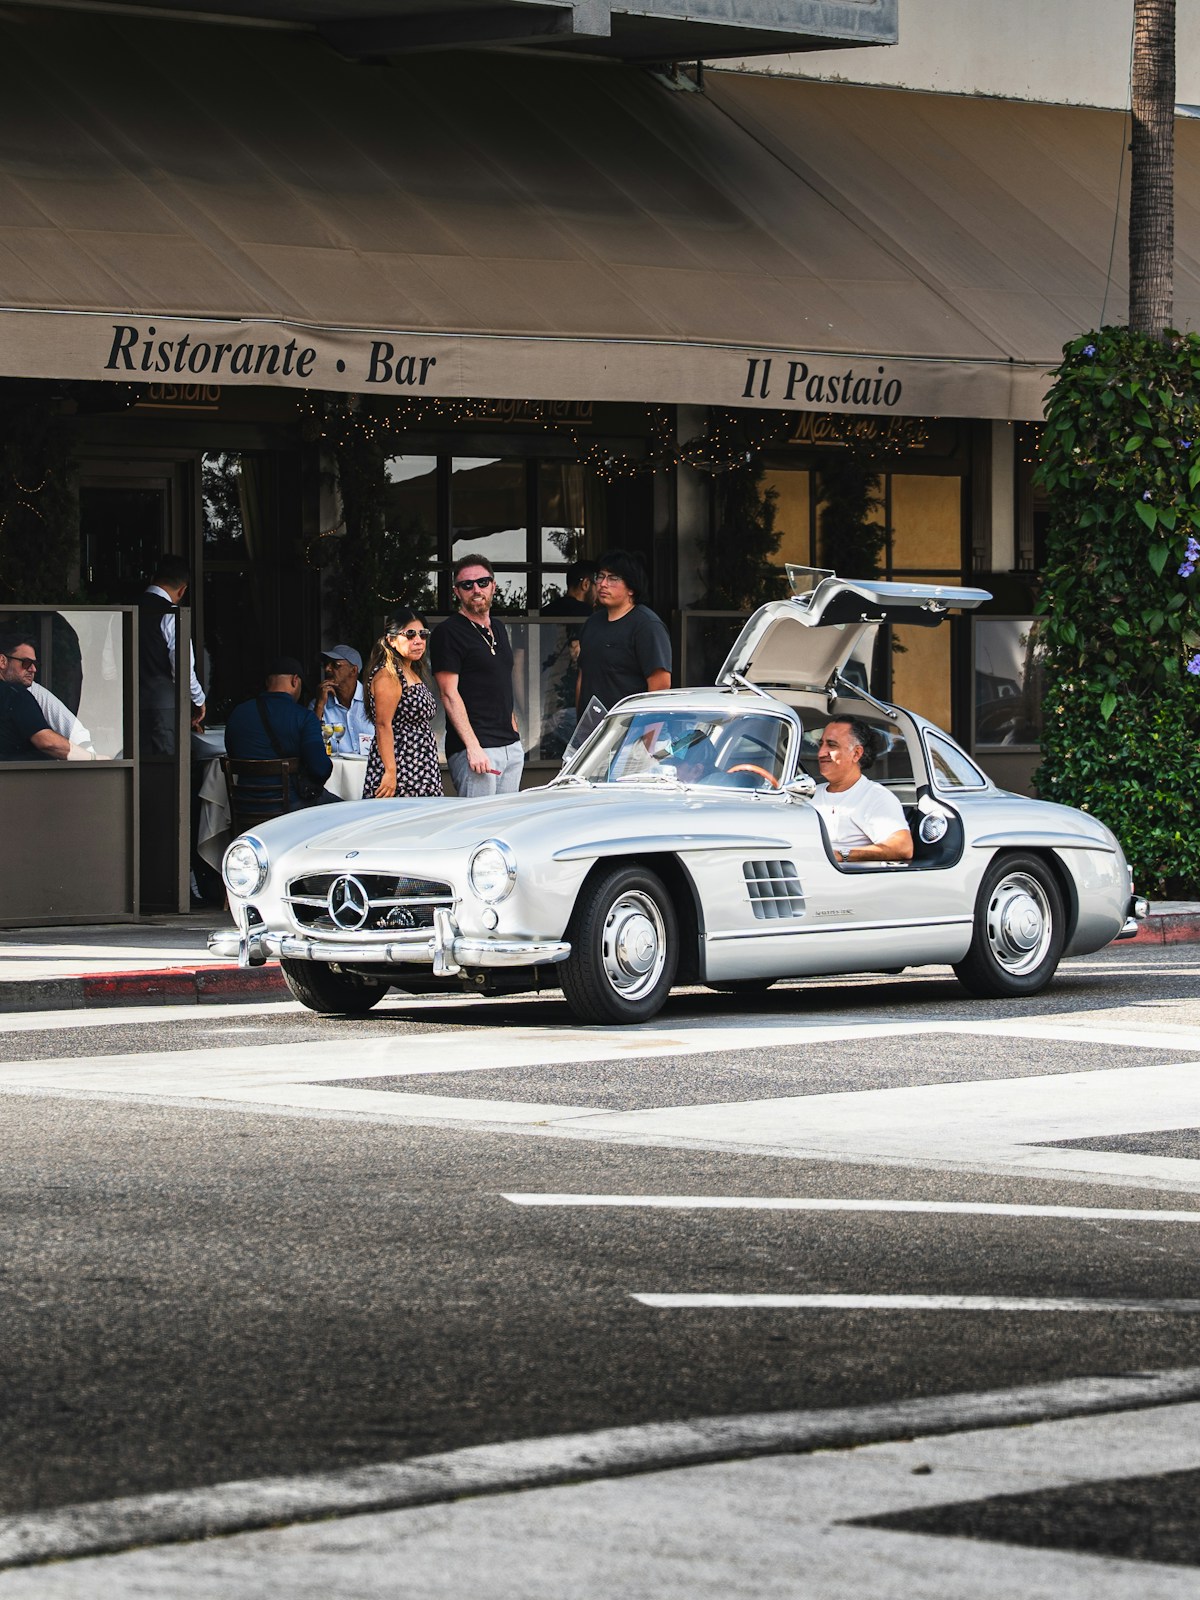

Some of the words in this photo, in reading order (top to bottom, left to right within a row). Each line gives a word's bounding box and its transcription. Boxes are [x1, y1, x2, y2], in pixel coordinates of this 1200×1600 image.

[104, 325, 317, 378] Ristorante
[365, 341, 437, 385] Bar
[741, 358, 772, 399] Il
[782, 361, 902, 407] Pastaio
